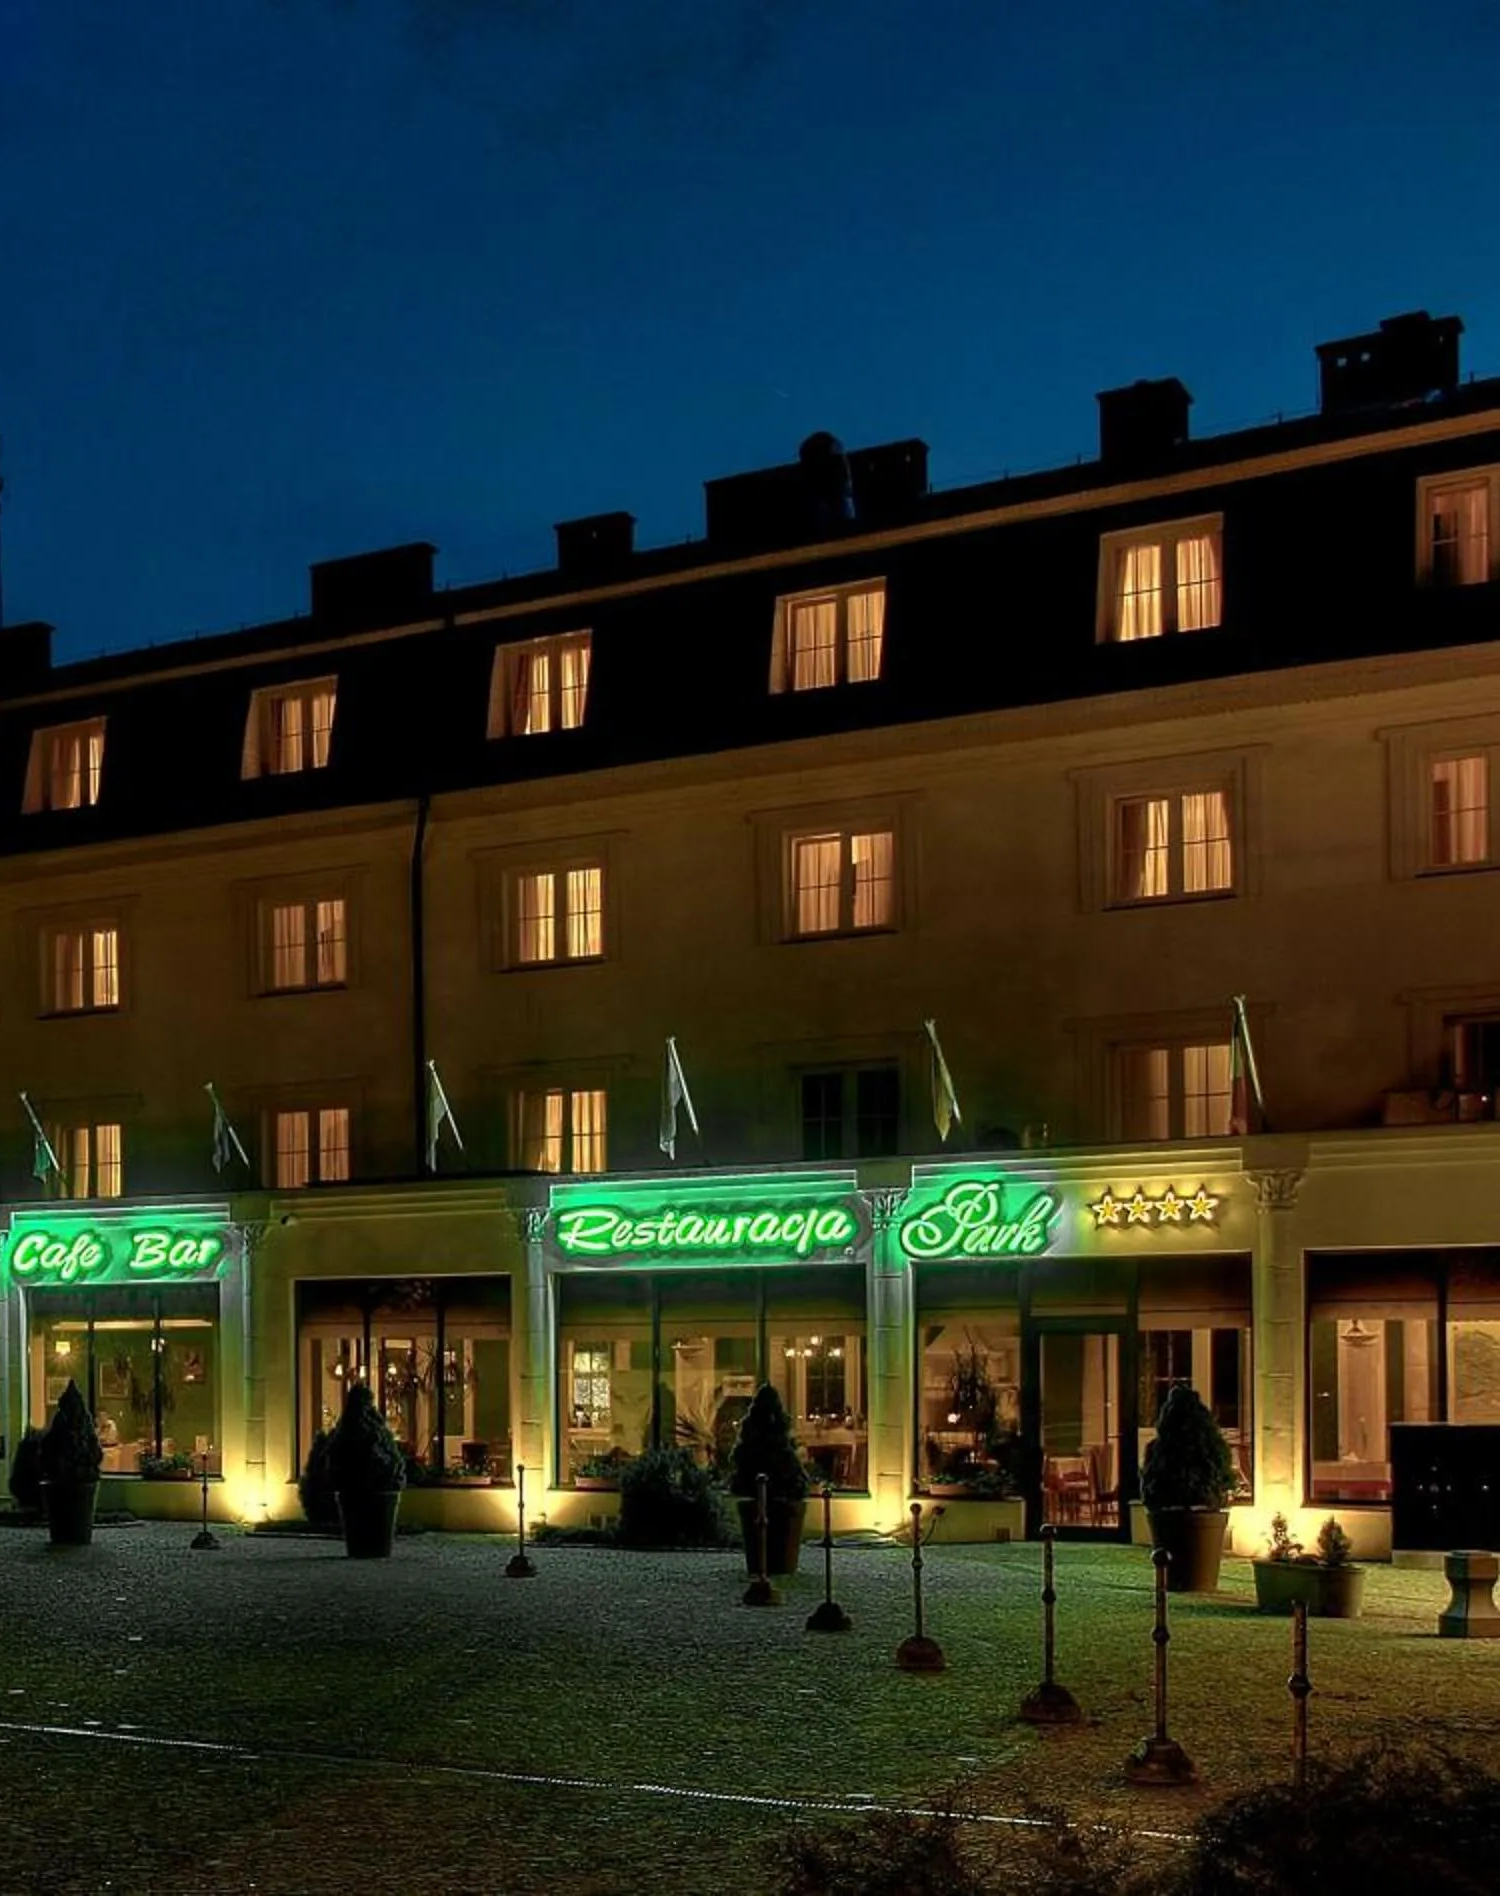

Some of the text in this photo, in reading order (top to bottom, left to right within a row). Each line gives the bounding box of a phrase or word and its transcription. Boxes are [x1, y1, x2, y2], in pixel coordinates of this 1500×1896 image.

[558, 1207, 852, 1254] Restauracja
[901, 1183, 1054, 1257] Park
[129, 1232, 221, 1268] Bar
